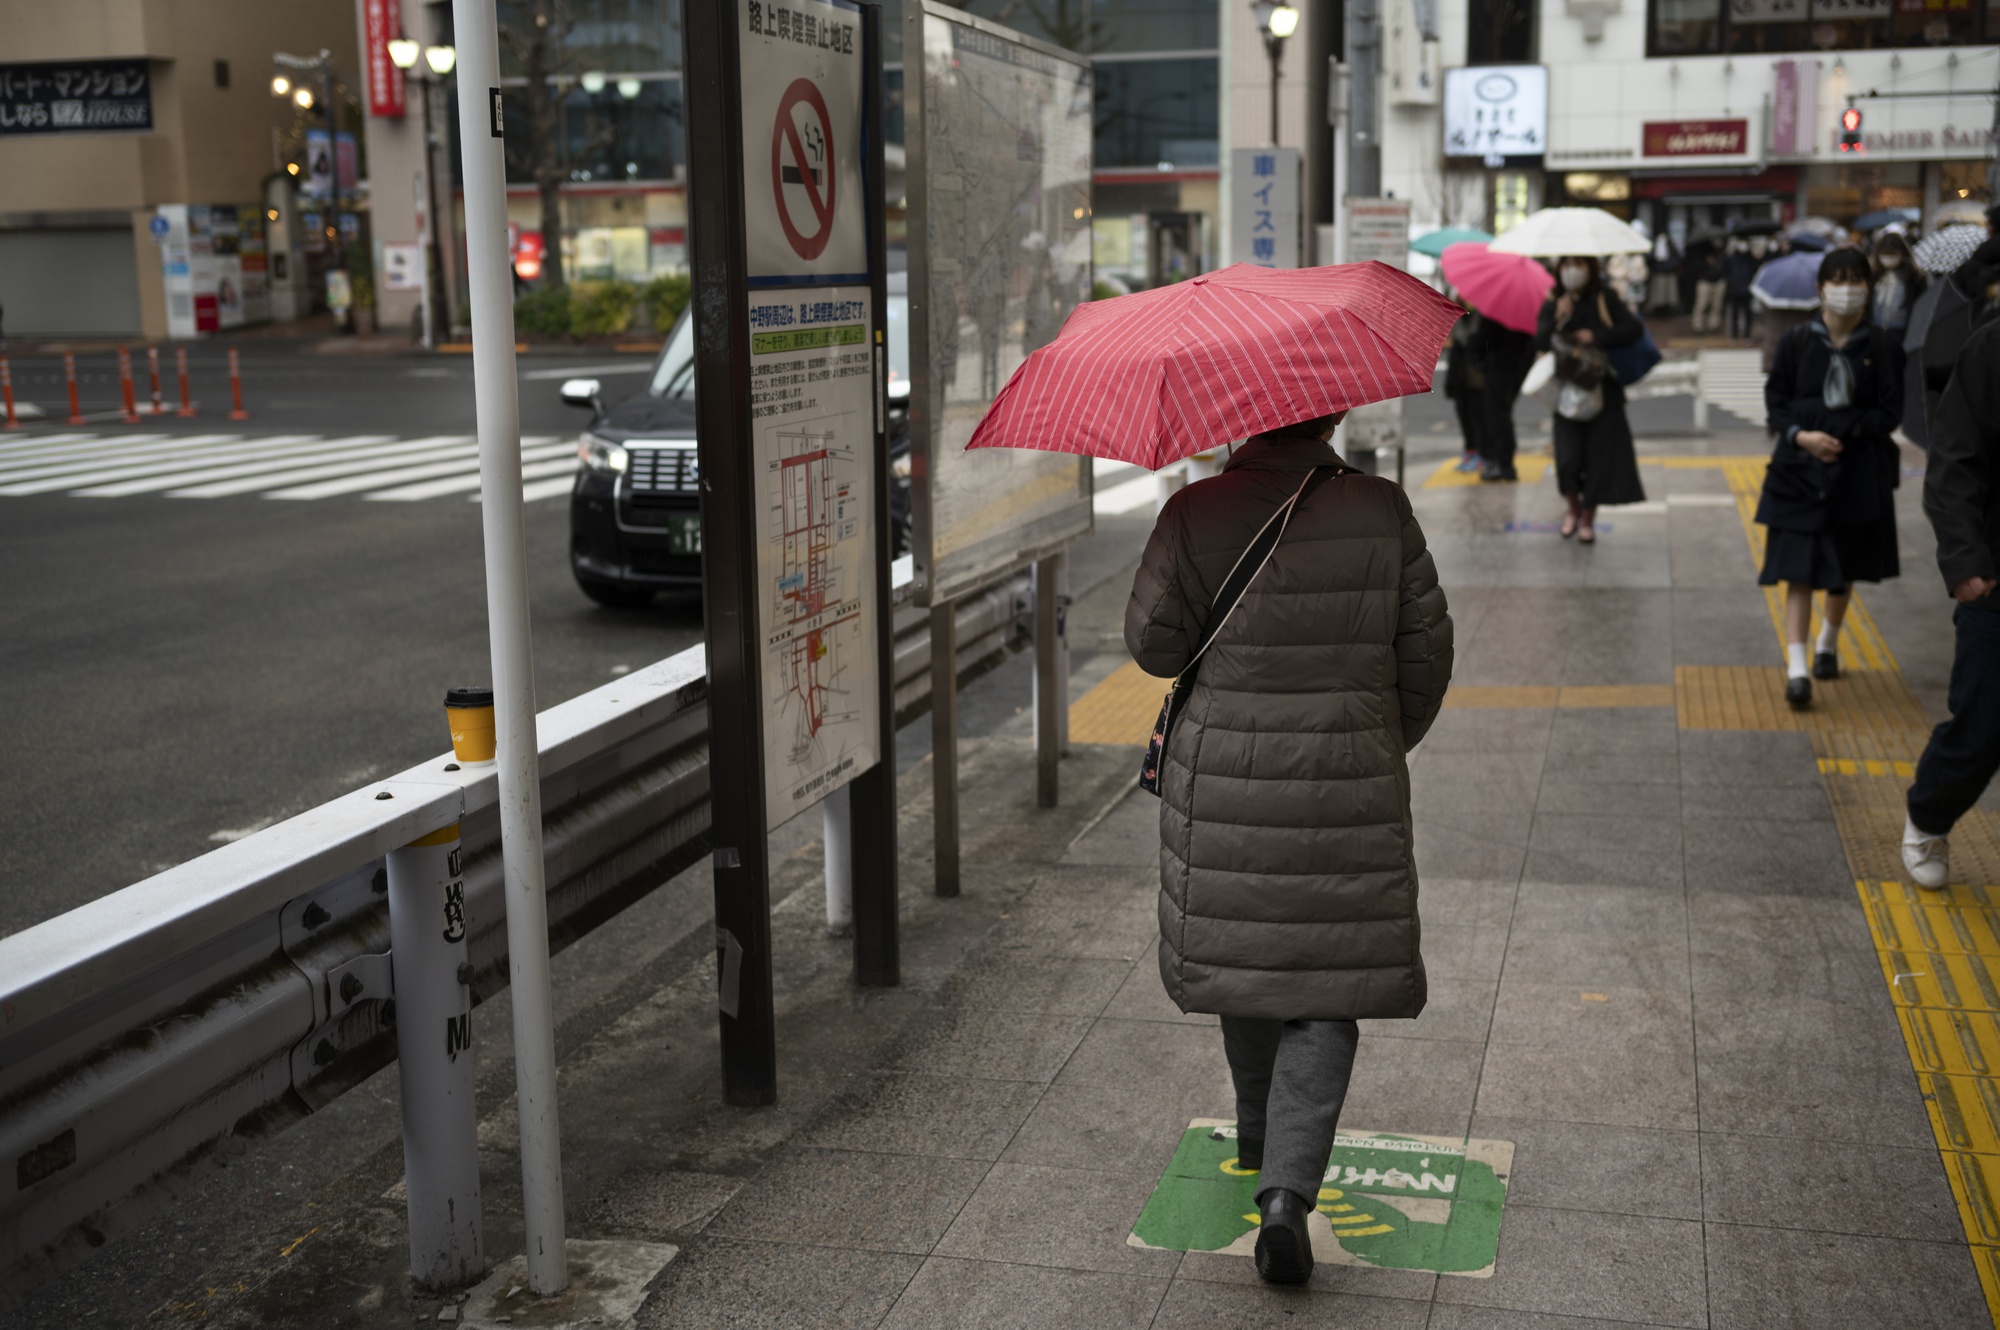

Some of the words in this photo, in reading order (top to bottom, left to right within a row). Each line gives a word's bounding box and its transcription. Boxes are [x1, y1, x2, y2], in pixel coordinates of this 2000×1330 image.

[748, 0, 853, 55] 路上喫煙禁止地区
